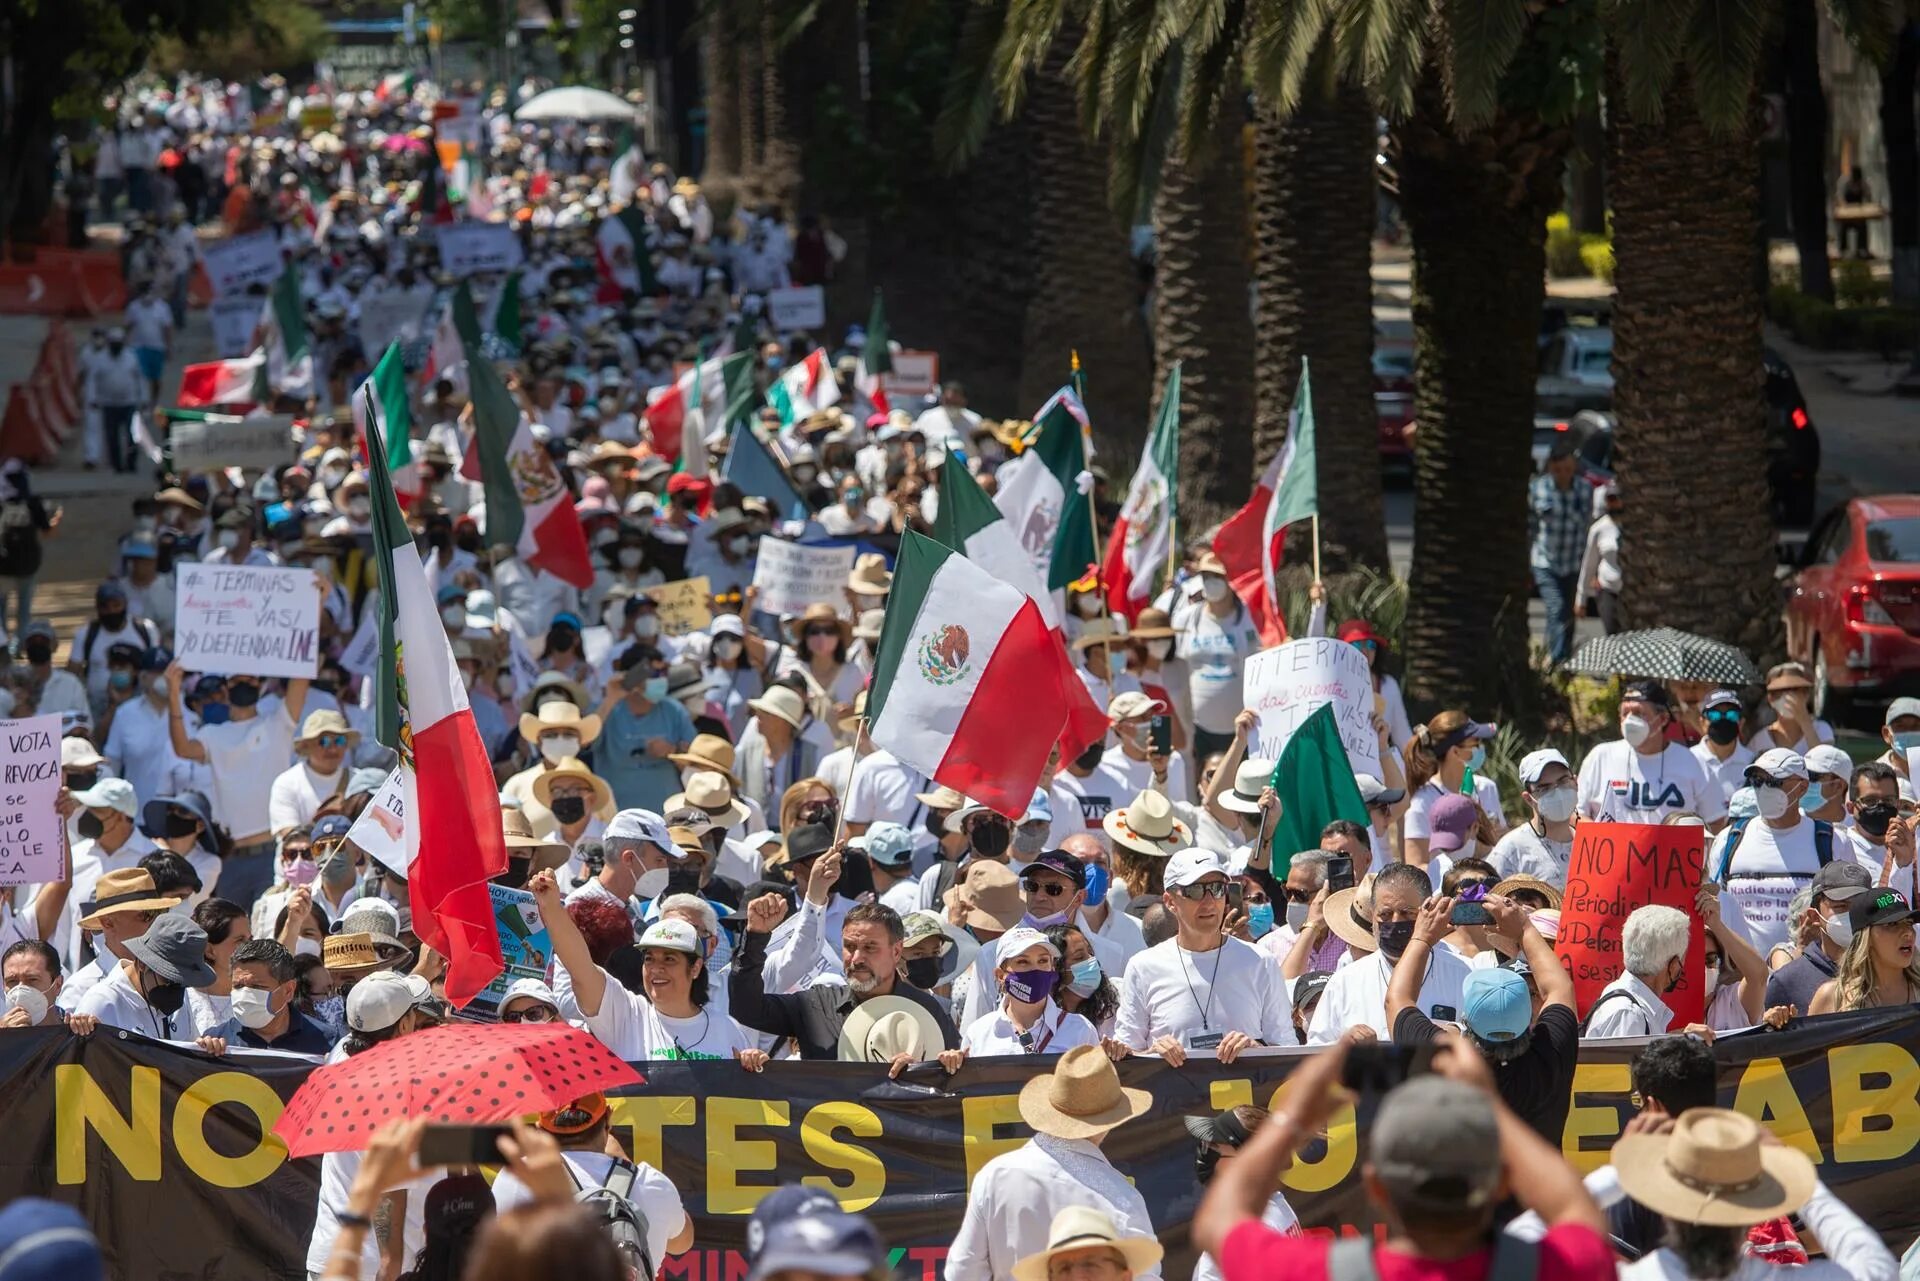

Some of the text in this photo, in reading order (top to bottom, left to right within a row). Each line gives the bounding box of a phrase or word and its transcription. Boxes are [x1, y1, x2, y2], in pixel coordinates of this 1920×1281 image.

[200, 609, 235, 626] TE
[9, 731, 51, 754] VOTA
[22, 842, 44, 857] LE
[1576, 836, 1615, 876] NO
[55, 1064, 289, 1188] NO
[605, 1096, 886, 1214] TES
